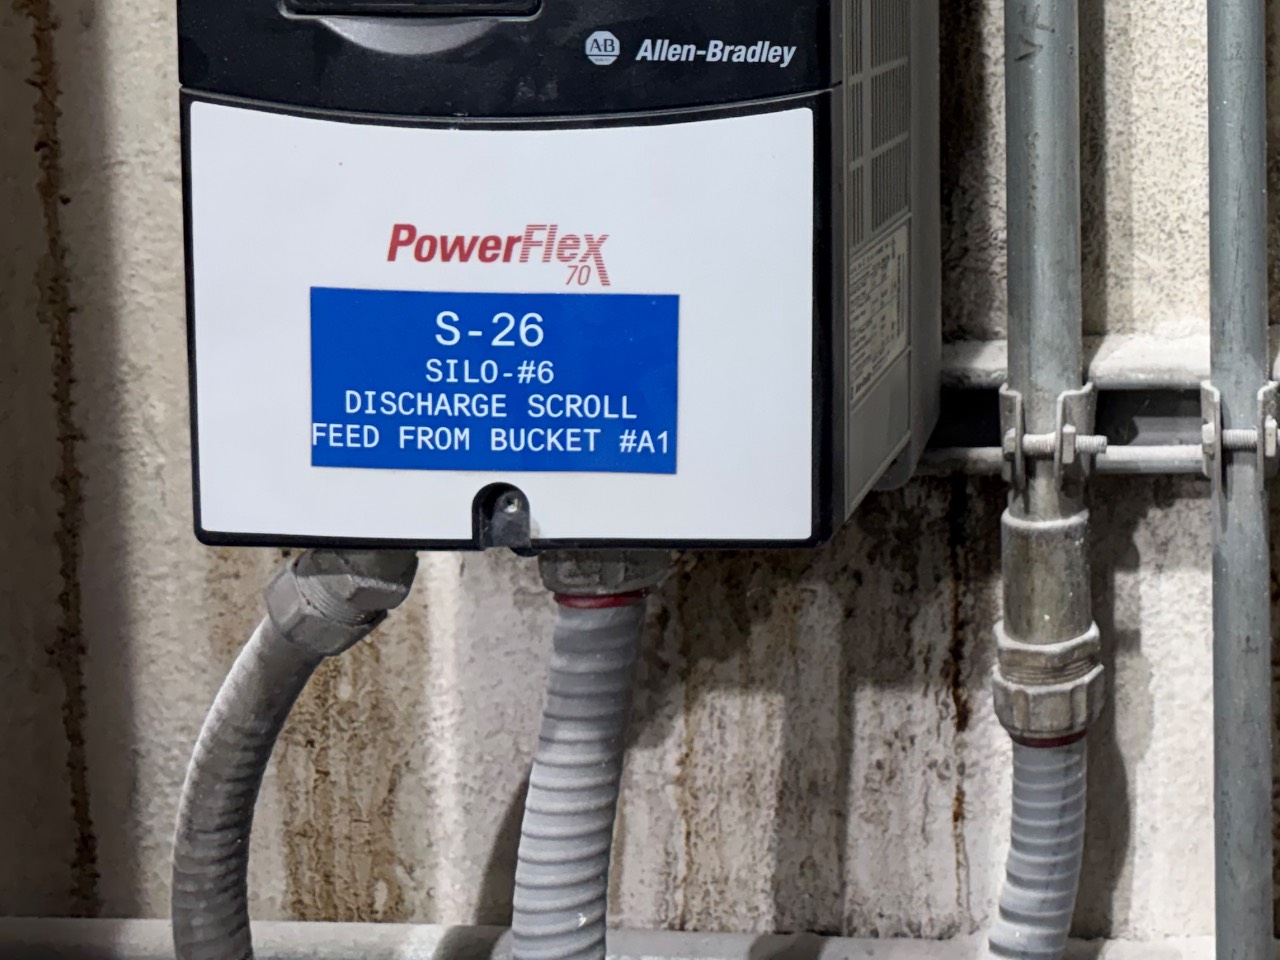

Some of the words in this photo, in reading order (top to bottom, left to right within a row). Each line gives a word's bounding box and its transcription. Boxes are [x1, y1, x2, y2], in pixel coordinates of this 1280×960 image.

[635, 39, 797, 68] Allen-Bradley
[387, 223, 611, 286] PowerFlex
[565, 265, 591, 286] 70
[435, 310, 544, 347] S-26
[426, 359, 554, 384] SILO-#6
[346, 390, 507, 418] DISCHARGE
[527, 394, 637, 419] SCROLL
[312, 423, 380, 448] FEED
[399, 426, 470, 451] FROM
[490, 428, 602, 452] BUCKET
[619, 430, 669, 454] #A1
